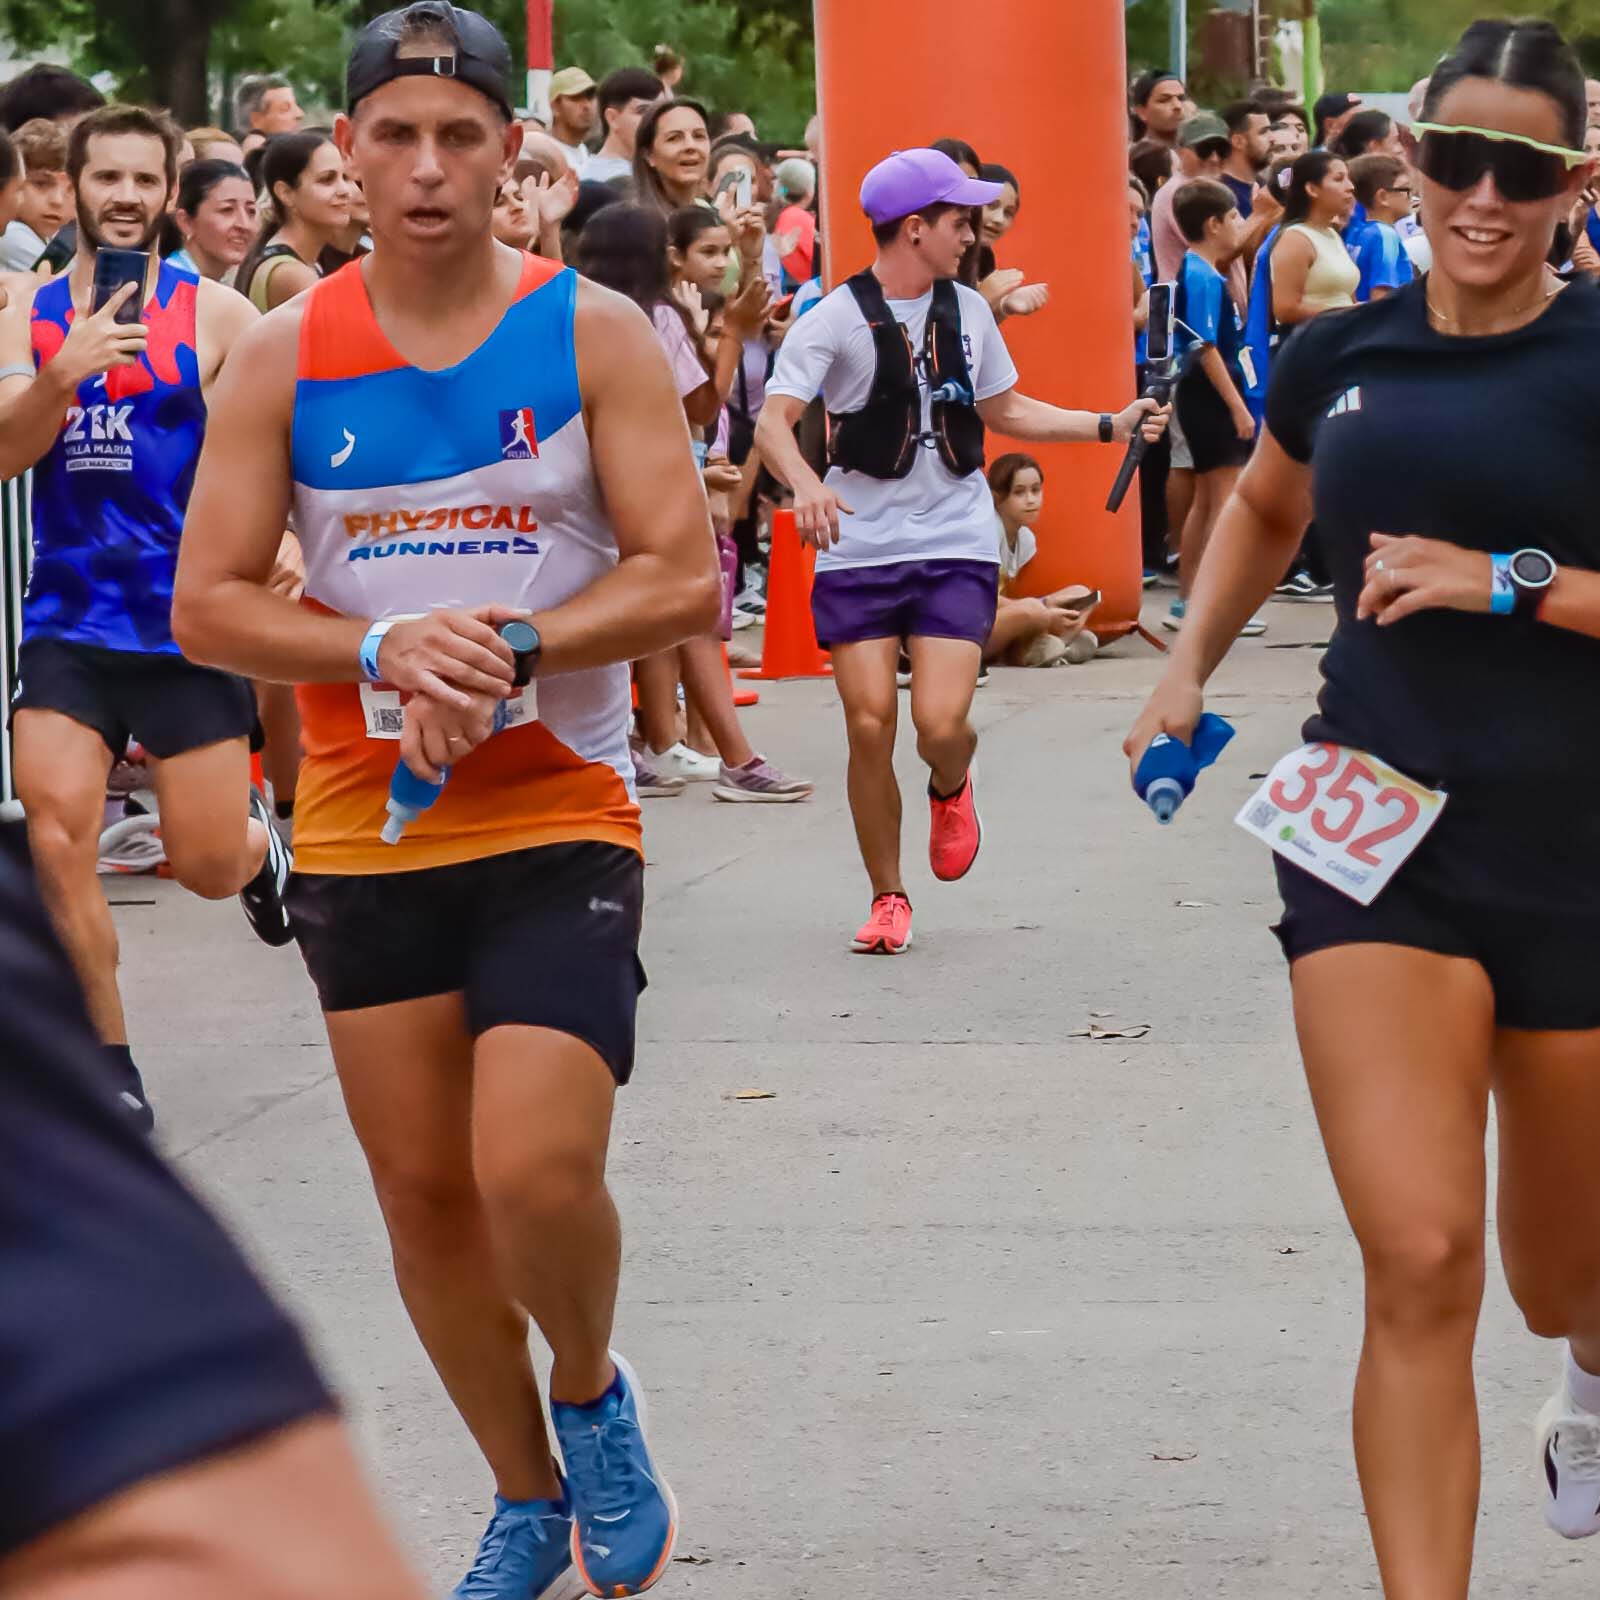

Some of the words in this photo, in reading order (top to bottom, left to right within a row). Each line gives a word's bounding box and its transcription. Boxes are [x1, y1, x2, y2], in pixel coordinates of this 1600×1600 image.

[93, 443, 133, 456] MARIA
[343, 504, 538, 538] PHYSICAL
[1268, 741, 1420, 867] 352
